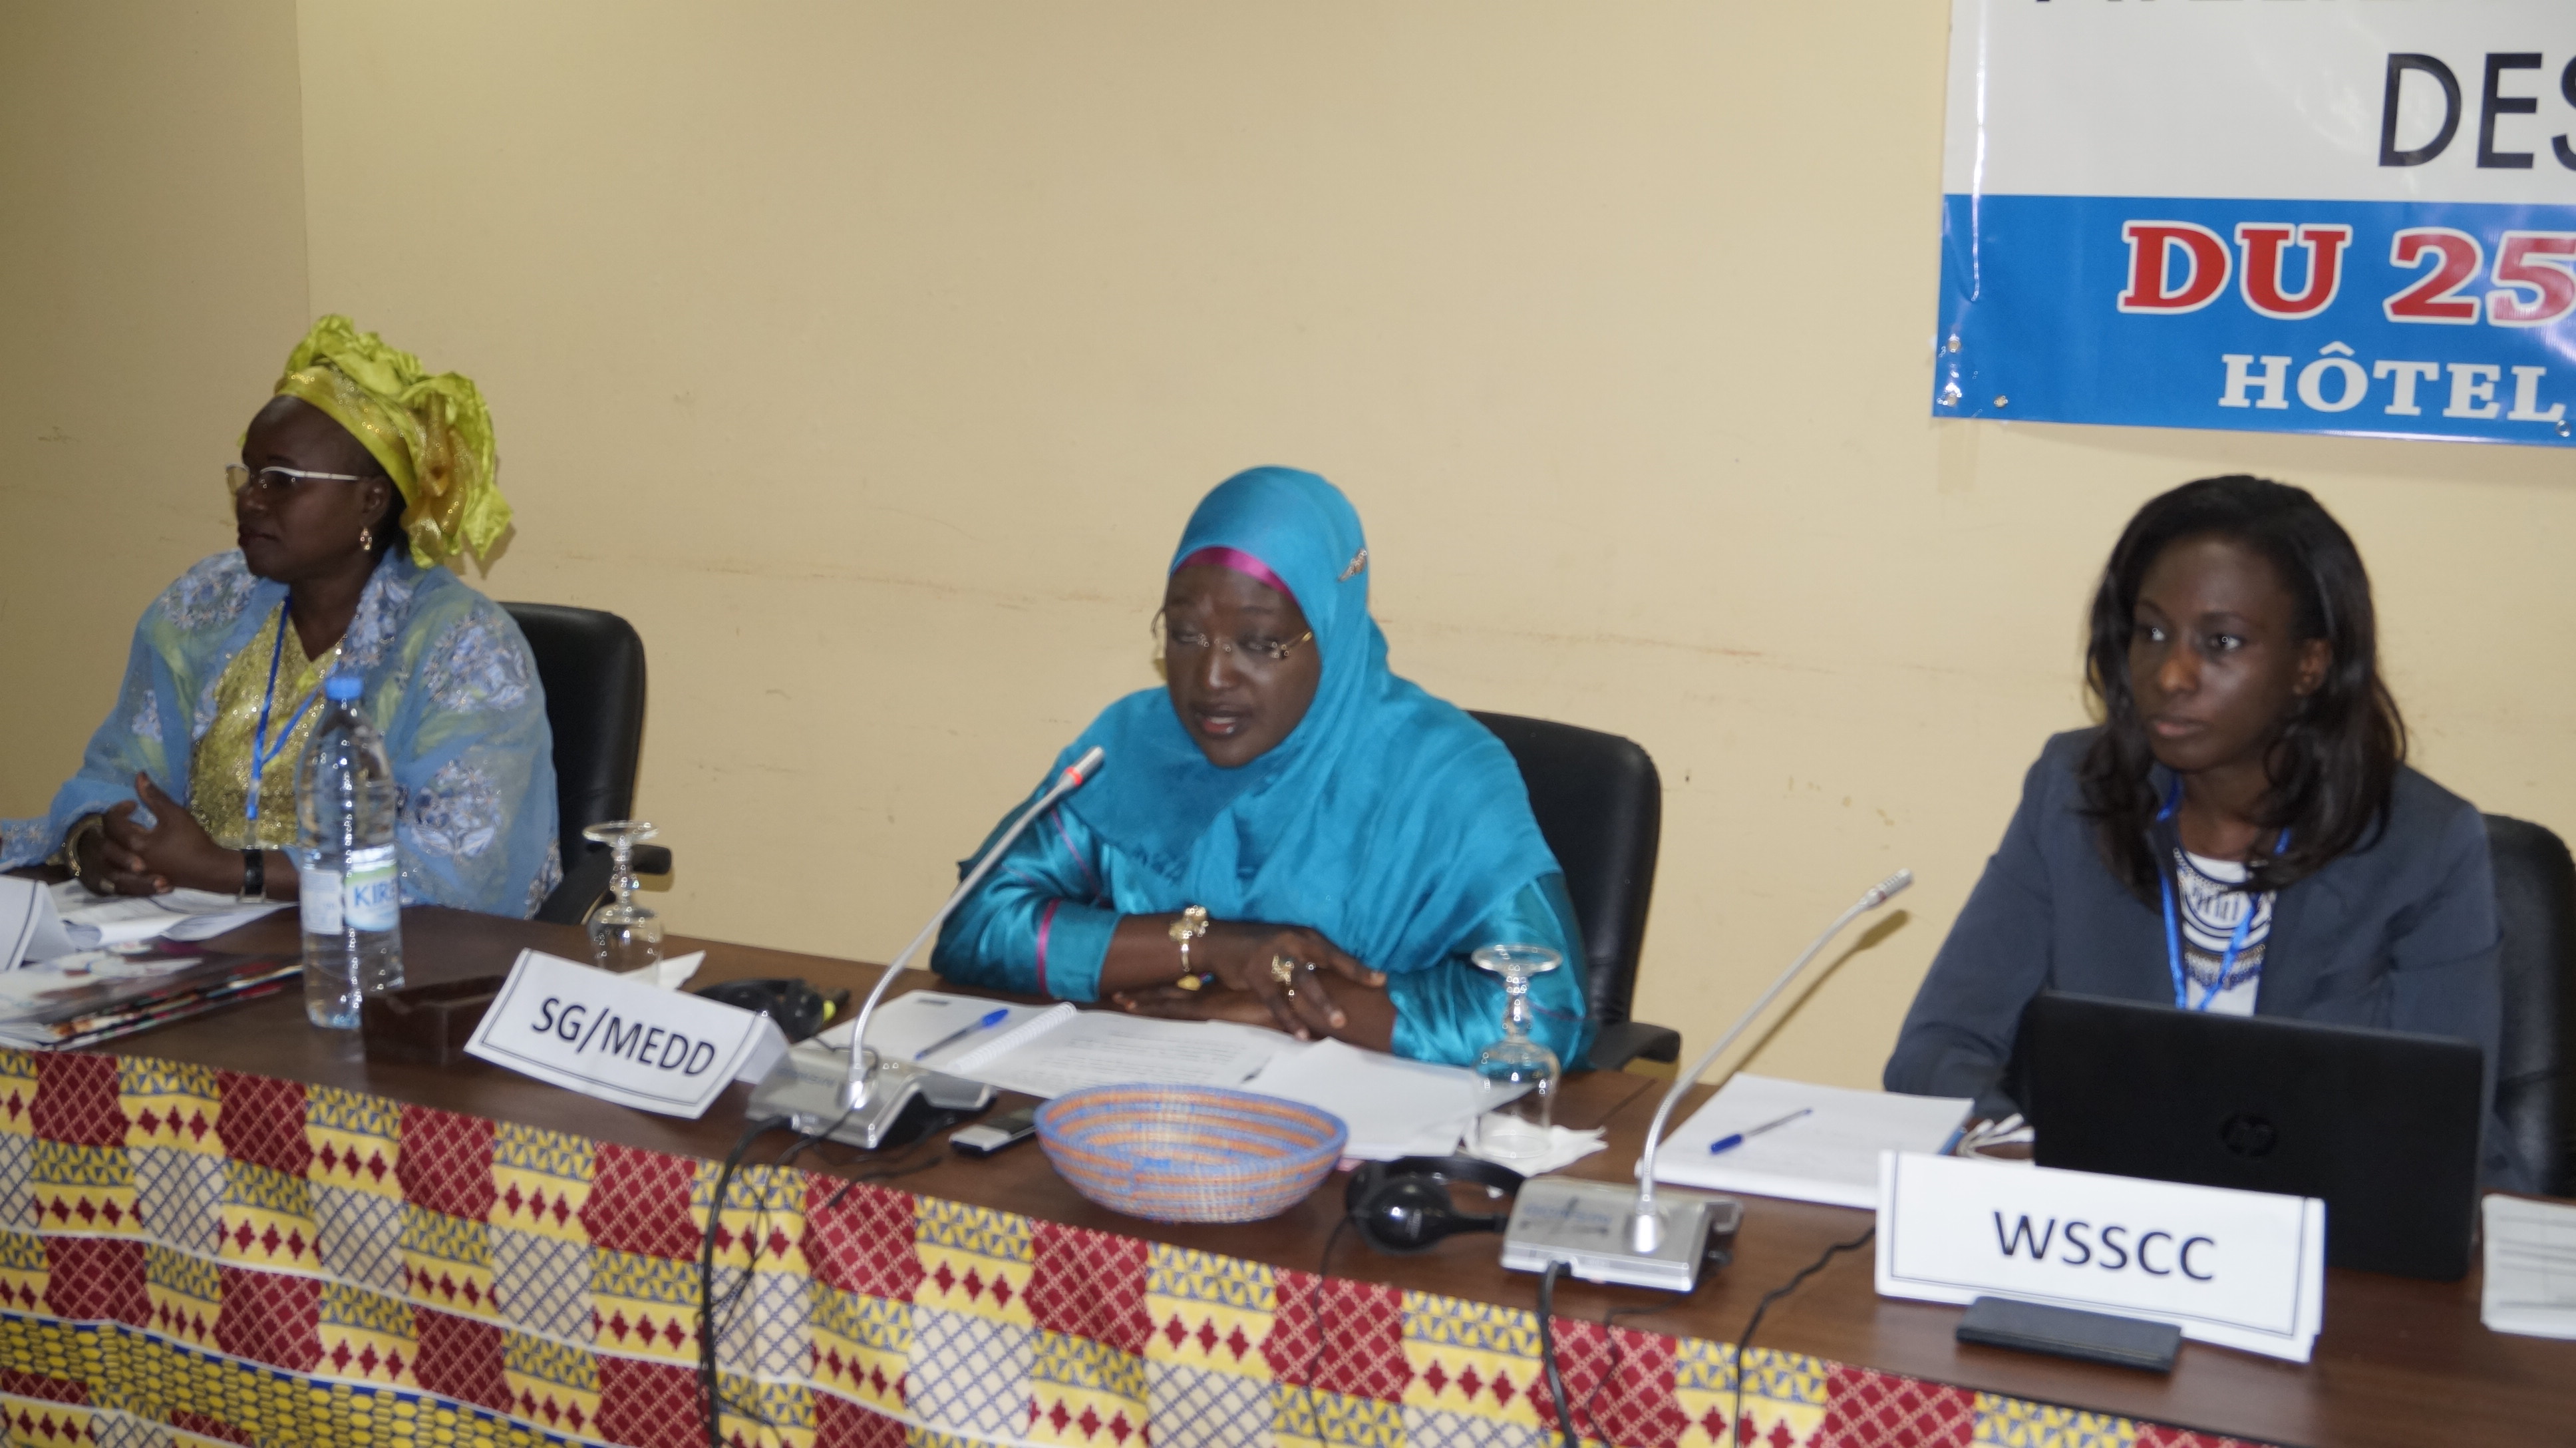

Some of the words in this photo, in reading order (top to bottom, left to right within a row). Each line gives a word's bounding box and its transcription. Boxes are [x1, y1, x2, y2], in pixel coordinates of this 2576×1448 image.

[2118, 220, 2353, 320] DU
[2382, 226, 2576, 327] 25
[2218, 341, 2566, 424] HÔTEL
[532, 997, 716, 1076] SG/MEDD
[1994, 1210, 2217, 1282] WSSCC
